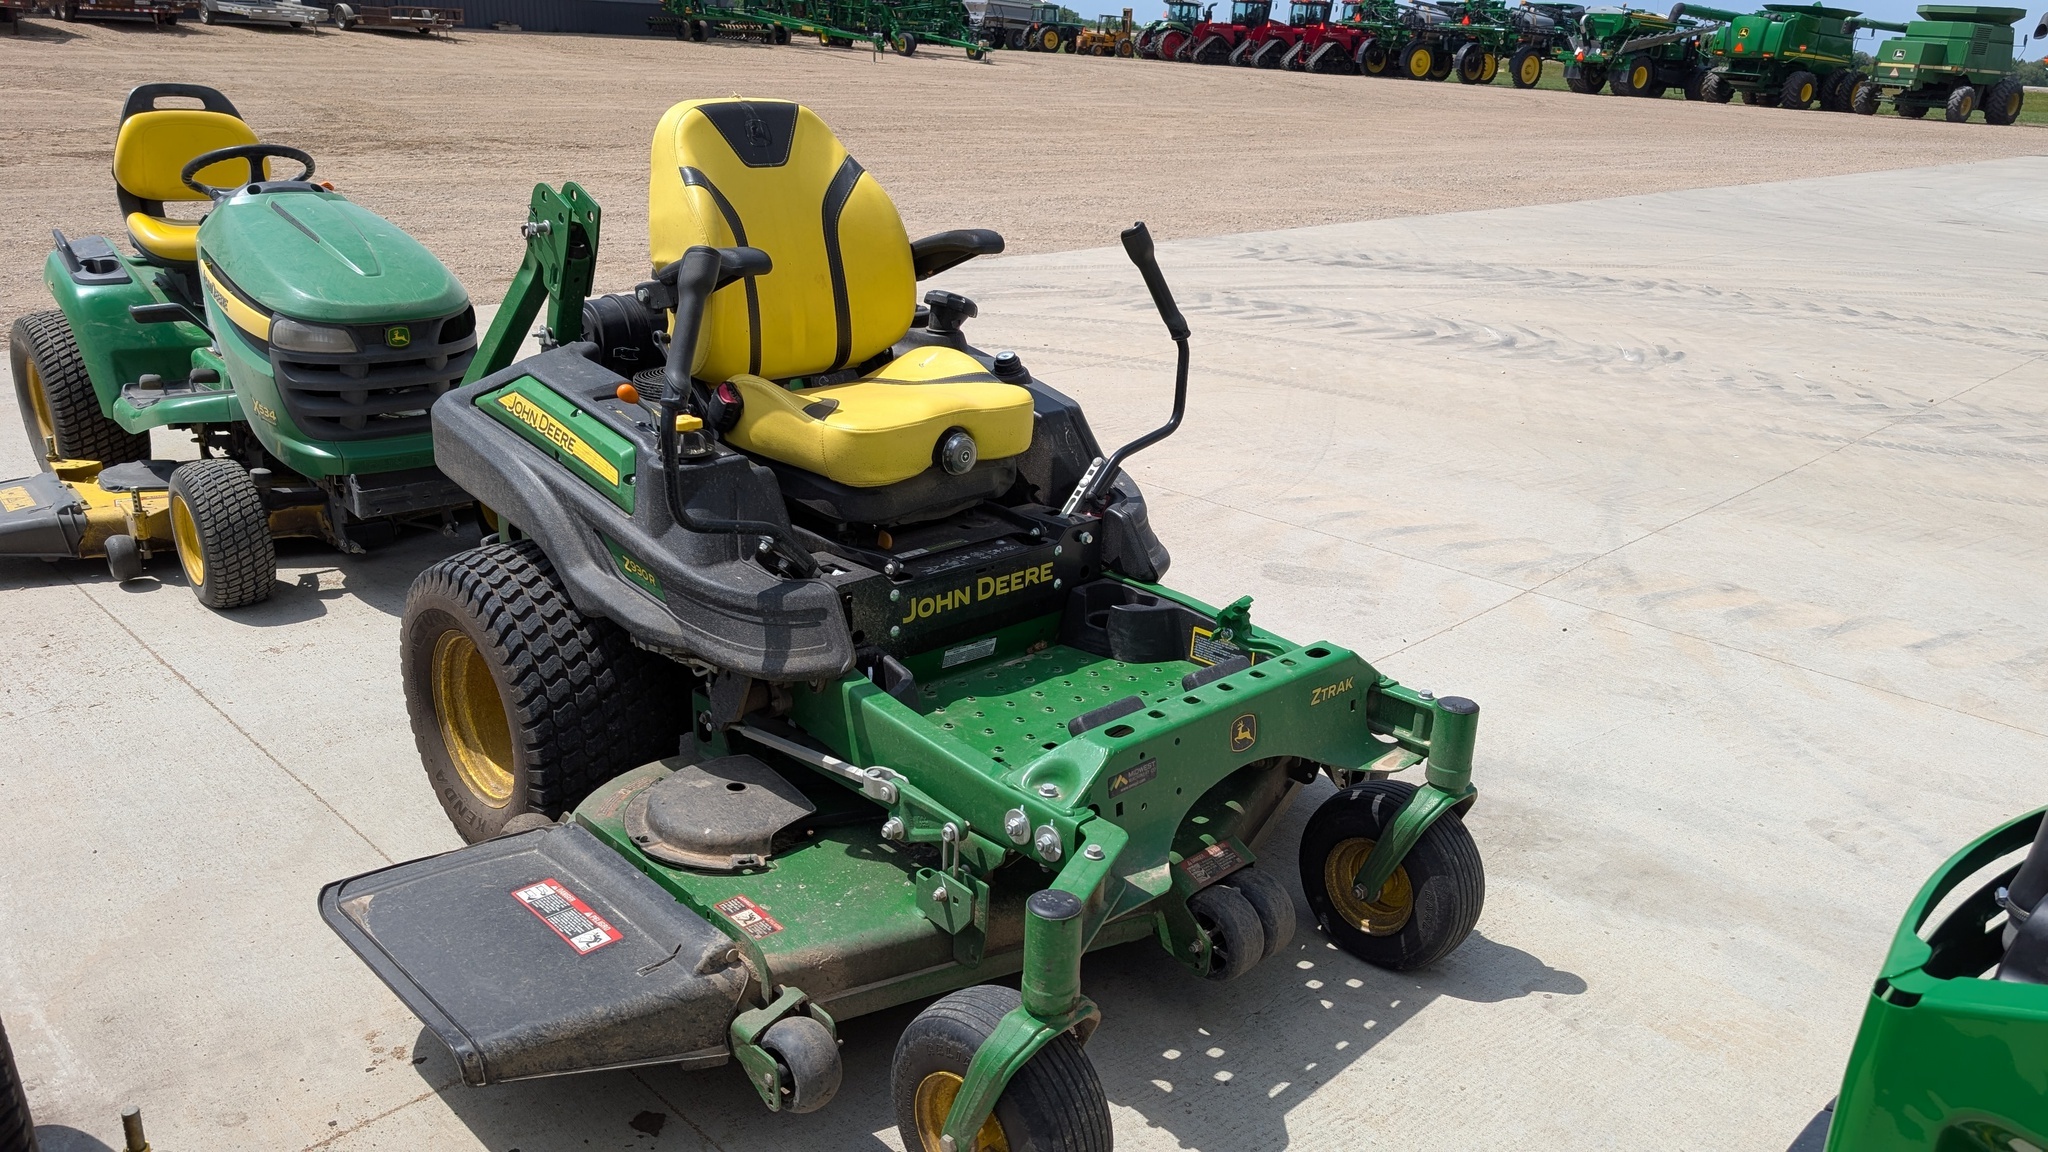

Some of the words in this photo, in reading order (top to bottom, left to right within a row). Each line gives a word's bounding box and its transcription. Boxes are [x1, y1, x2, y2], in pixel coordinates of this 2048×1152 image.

[251, 397, 277, 421] X534
[507, 395, 539, 429] JOHN
[537, 413, 577, 455] DEERE
[621, 555, 657, 587] Z930R
[902, 585, 971, 624] JOHN
[977, 561, 1054, 602] DEERE
[1310, 676, 1355, 706] ZTRAK
[1128, 760, 1156, 777] MIDWEST
[435, 768, 487, 834] KENDA
[556, 888, 576, 902] DANGER
